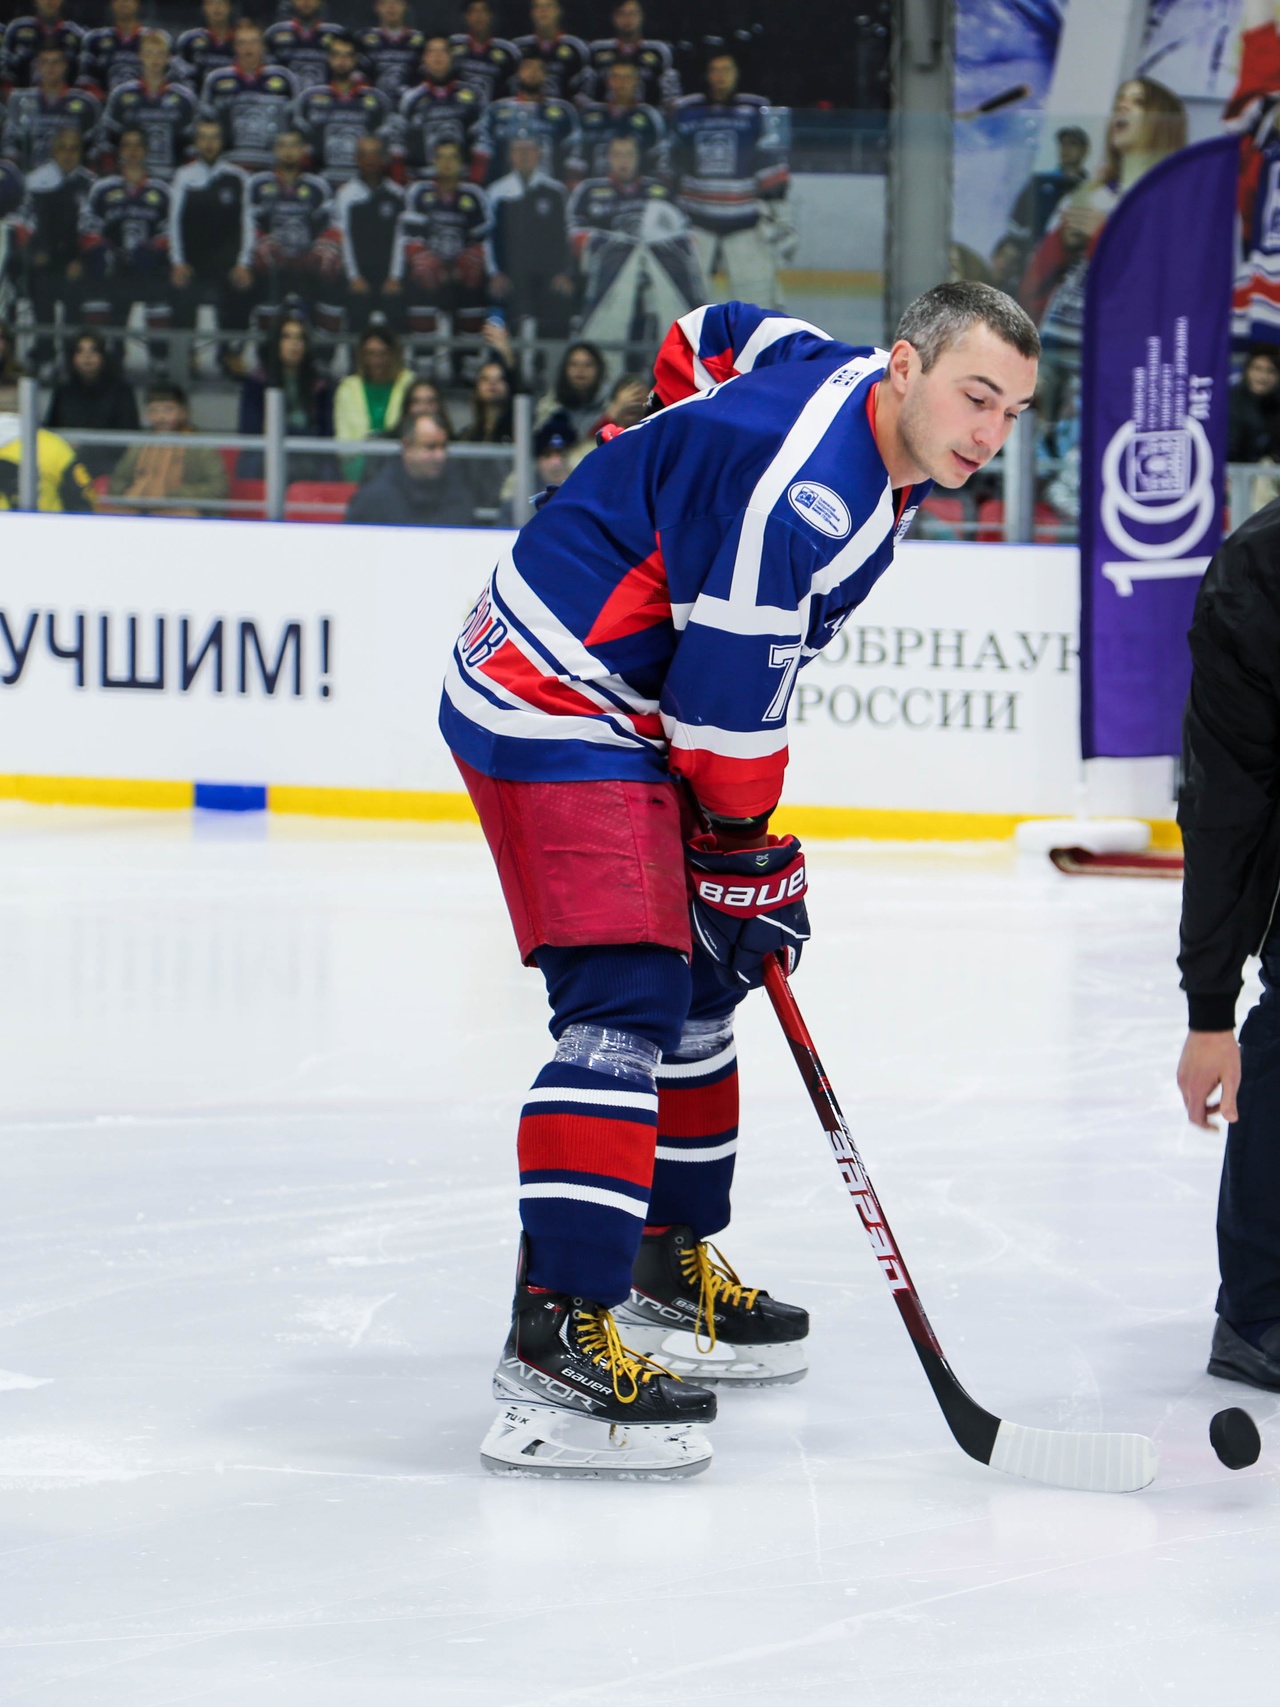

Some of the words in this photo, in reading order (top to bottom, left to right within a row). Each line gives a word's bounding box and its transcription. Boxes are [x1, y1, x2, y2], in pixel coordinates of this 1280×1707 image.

[0, 612, 332, 698] УЧШИМ!
[795, 684, 1021, 730] РОССИИ
[700, 866, 804, 907] BAUE
[501, 1357, 594, 1412] VAPOR
[561, 1366, 613, 1396] BAUER
